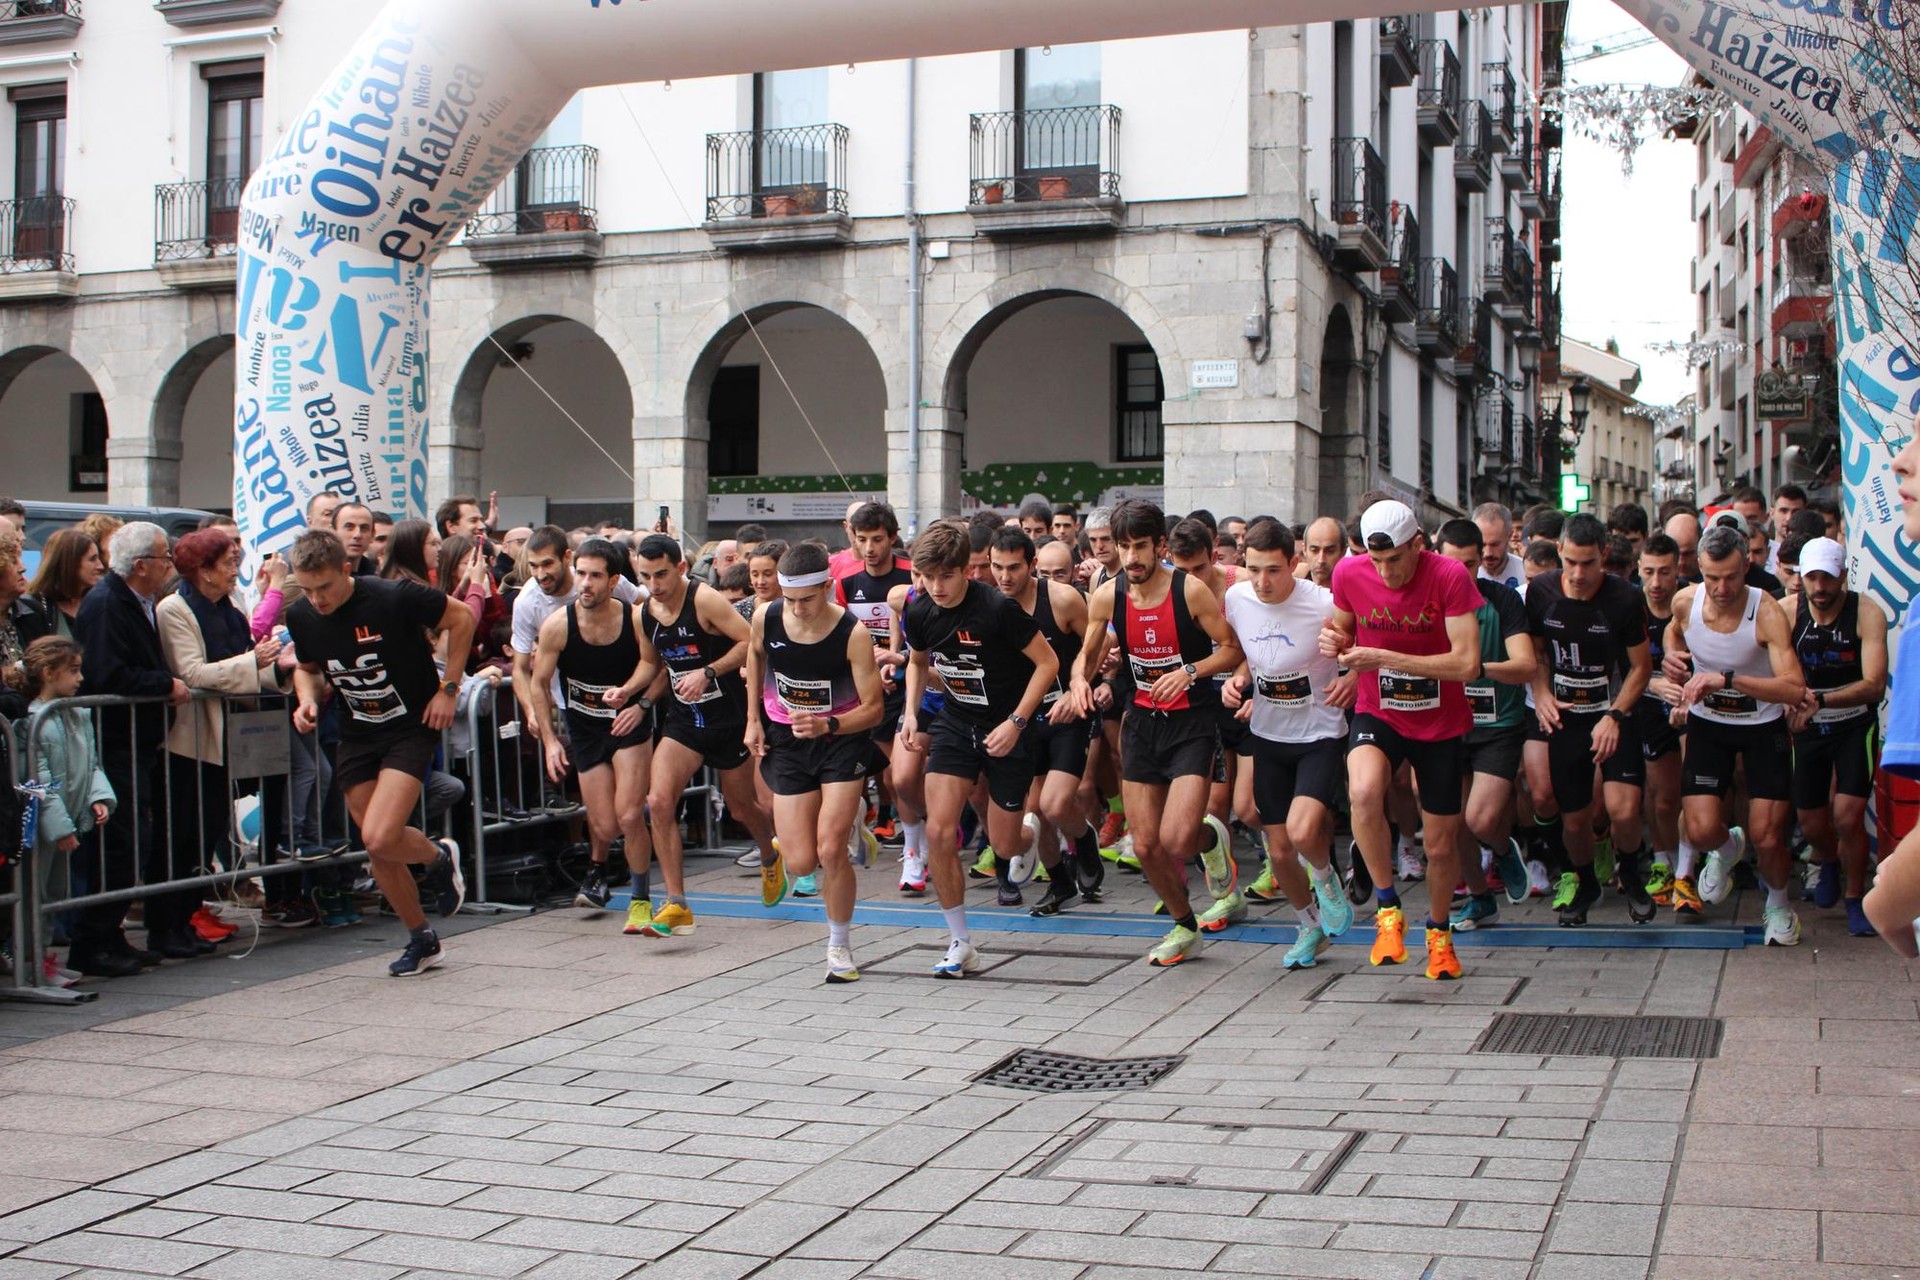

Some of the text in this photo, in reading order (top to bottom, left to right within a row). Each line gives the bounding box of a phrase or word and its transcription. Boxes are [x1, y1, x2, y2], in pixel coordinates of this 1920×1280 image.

[1690, 5, 1841, 117] Haizea
[1711, 58, 1760, 98] Eneritz
[411, 64, 434, 109] Nikole
[391, 62, 488, 193] Haizea
[462, 94, 512, 129] Julia
[1769, 98, 1809, 134] Julia
[450, 133, 482, 179] Eneritz
[389, 185, 406, 210] Ander
[300, 210, 360, 243] Maren
[246, 331, 267, 388] Ainhize
[397, 331, 415, 377] Emma
[1864, 342, 1885, 366] Aratz
[265, 345, 292, 413] Naroa
[297, 379, 320, 392] Hugo
[351, 403, 370, 442] Julia
[279, 425, 310, 468] Nikole
[303, 391, 361, 503] aizea
[359, 452, 381, 503] Eneritz
[1871, 475, 1893, 525] Kattalin
[1133, 646, 1174, 654] SUANZES
[1381, 677, 1394, 686] AS
[1405, 682, 1412, 691] 2
